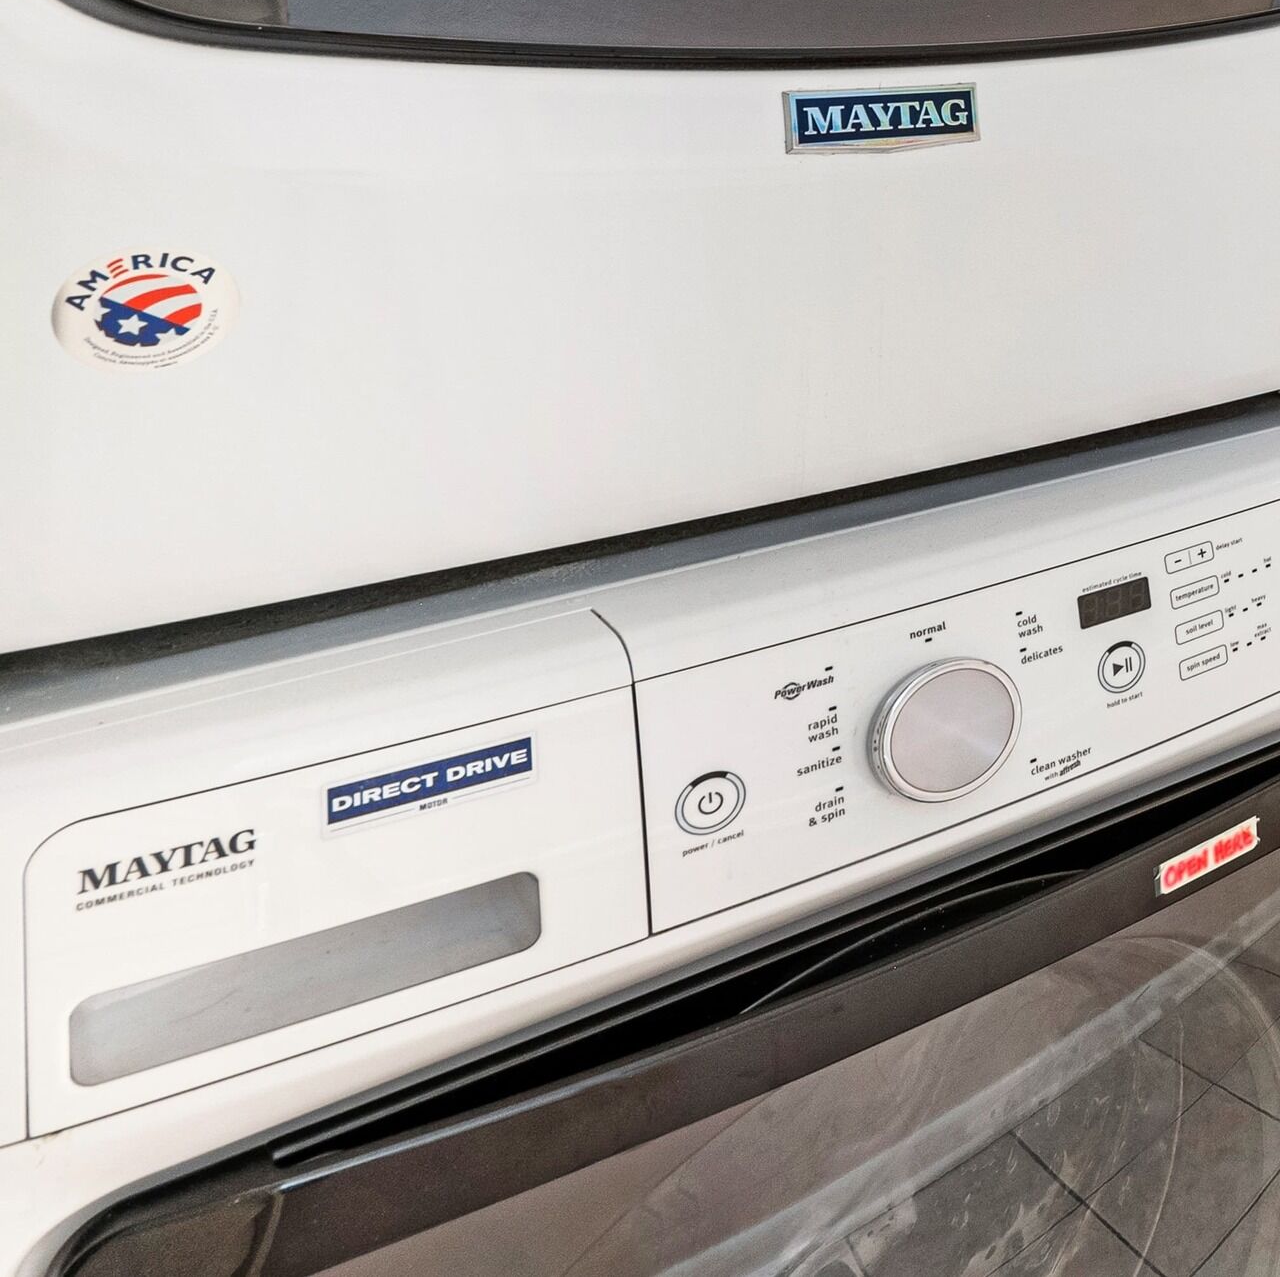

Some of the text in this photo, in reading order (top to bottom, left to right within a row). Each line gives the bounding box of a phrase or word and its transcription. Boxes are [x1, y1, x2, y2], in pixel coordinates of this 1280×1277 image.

[802, 98, 969, 136] MAYTAG
[65, 252, 216, 311] AMERICA
[1215, 541, 1230, 551] delay
[1082, 571, 1142, 594] estimated cycle time
[1175, 583, 1214, 602] temperature
[909, 621, 947, 640] normal
[1016, 614, 1037, 628] cold
[1018, 623, 1044, 638] wash
[1185, 619, 1214, 636] soil level
[1020, 644, 1064, 665] delicates
[1186, 652, 1221, 672] spin speed
[773, 674, 835, 701] PowerWash
[1106, 691, 1144, 709] hold to start
[807, 713, 838, 732] rapid
[807, 726, 840, 743] wash
[796, 754, 843, 777] sanitize
[1030, 746, 1092, 776] clean washer
[330, 748, 529, 815] DIRECT DRIVE
[1044, 770, 1059, 781] with
[418, 797, 449, 812] MOTOR
[814, 795, 845, 813] drain
[808, 808, 846, 827] & spin
[682, 841, 709, 858] power
[717, 830, 745, 845] cancel
[77, 828, 257, 896] MAYTAG
[1164, 830, 1253, 887] OPEN HERE
[75, 858, 255, 912] COMMERCIAL TECHNOLOGY
